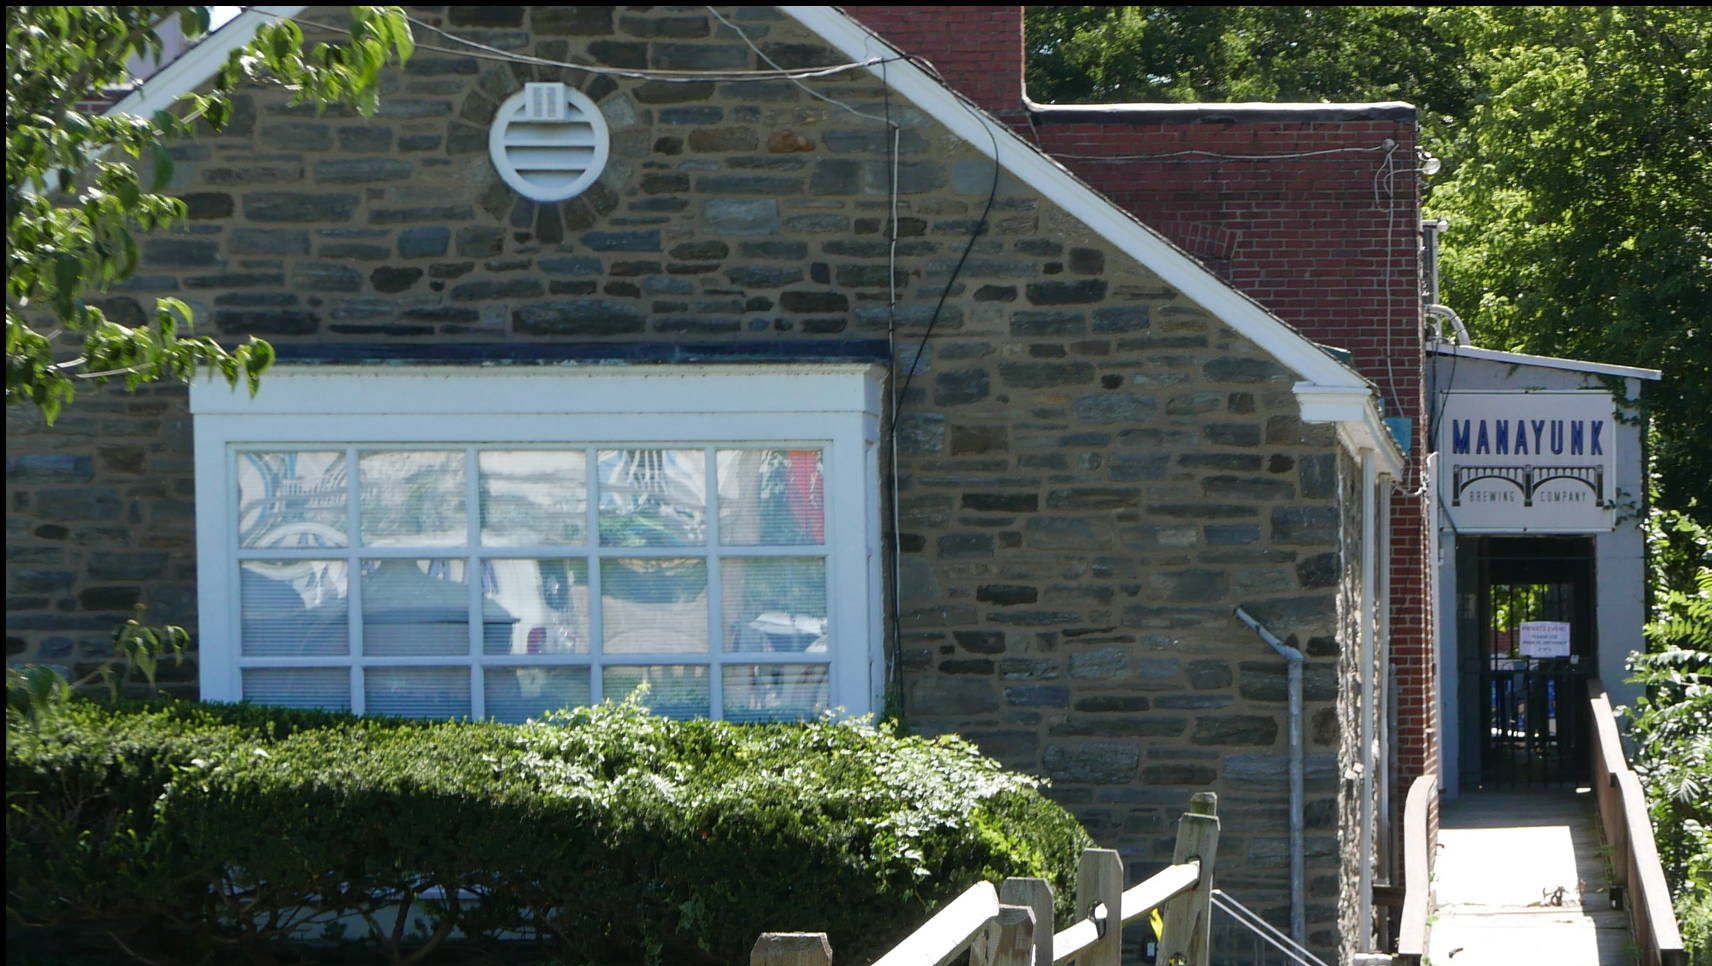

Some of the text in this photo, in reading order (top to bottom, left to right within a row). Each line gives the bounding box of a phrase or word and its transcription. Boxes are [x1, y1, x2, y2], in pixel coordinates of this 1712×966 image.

[1452, 419, 1604, 455] MANAYUNK
[1469, 490, 1587, 503] BREWING COMPANY
